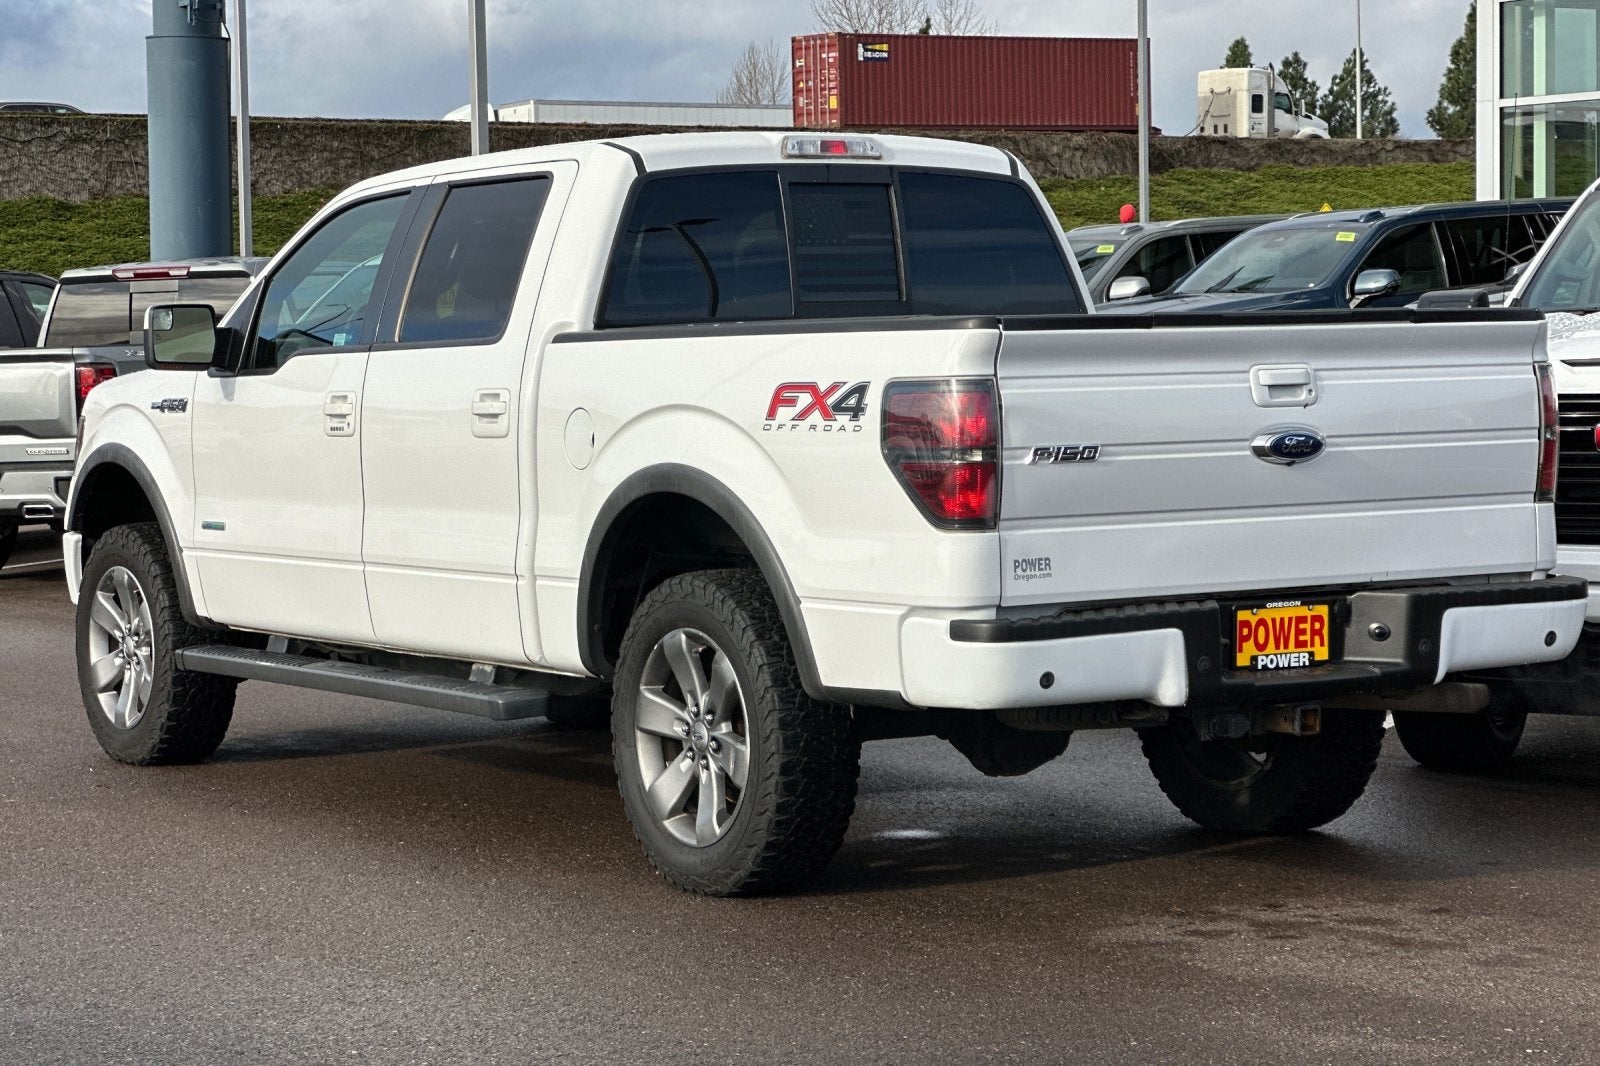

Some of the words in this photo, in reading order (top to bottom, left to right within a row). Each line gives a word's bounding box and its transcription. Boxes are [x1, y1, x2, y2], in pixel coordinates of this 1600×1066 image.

[765, 381, 871, 421] FX4
[808, 424, 863, 432] ROAD
[1282, 436, 1313, 453] Ford
[1013, 557, 1052, 573] POWER
[1013, 573, 1053, 581] Oregon.com
[1237, 614, 1325, 653] POWER
[1257, 653, 1310, 670] POWER
